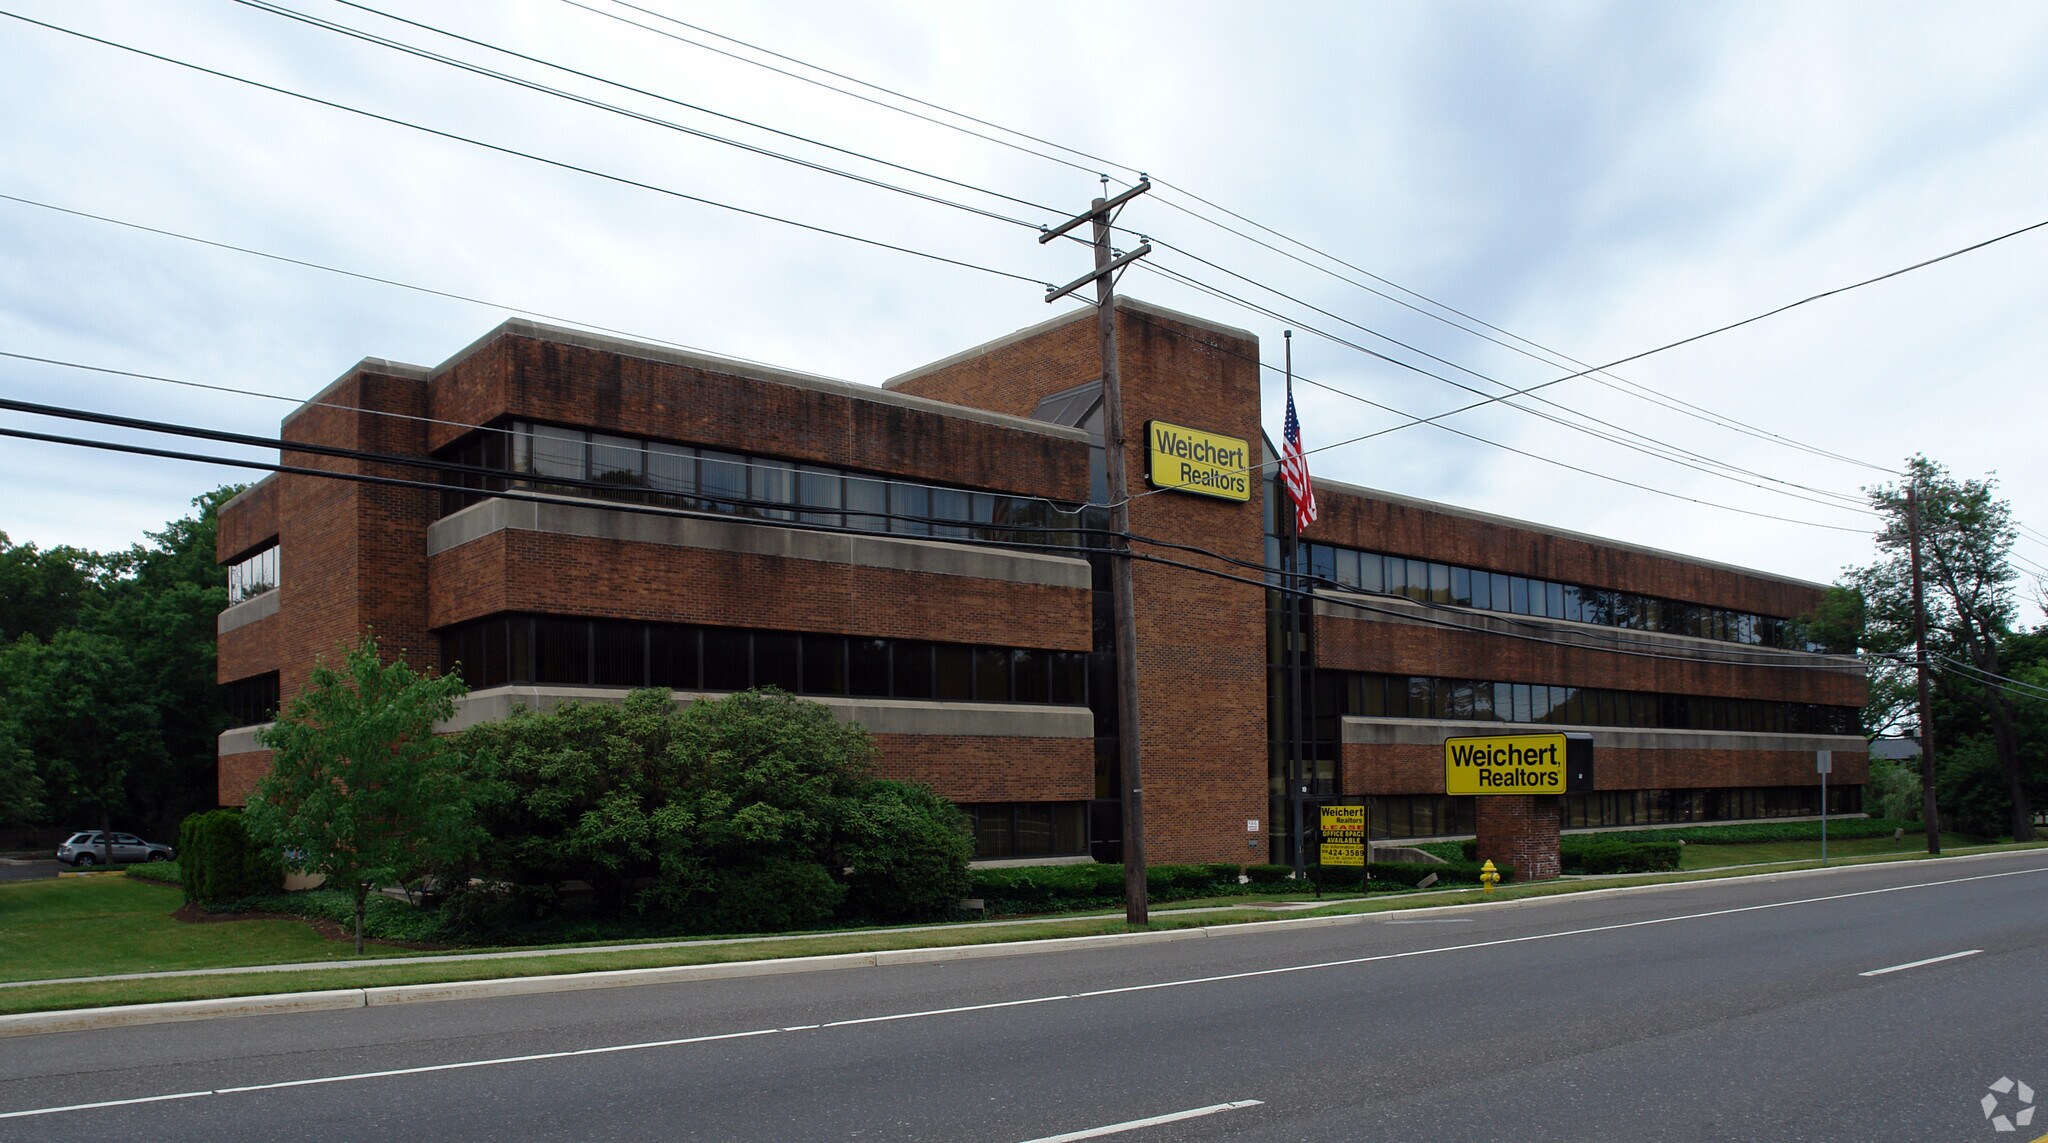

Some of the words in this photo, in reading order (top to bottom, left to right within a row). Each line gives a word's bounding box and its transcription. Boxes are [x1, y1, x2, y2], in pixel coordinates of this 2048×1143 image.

[1180, 462, 1245, 493] Realtors
[1451, 743, 1561, 768] Weichert,
[1479, 767, 1559, 787] Realtors
[1321, 807, 1364, 817] Weichert
[1328, 849, 1365, 857] 424-3589
